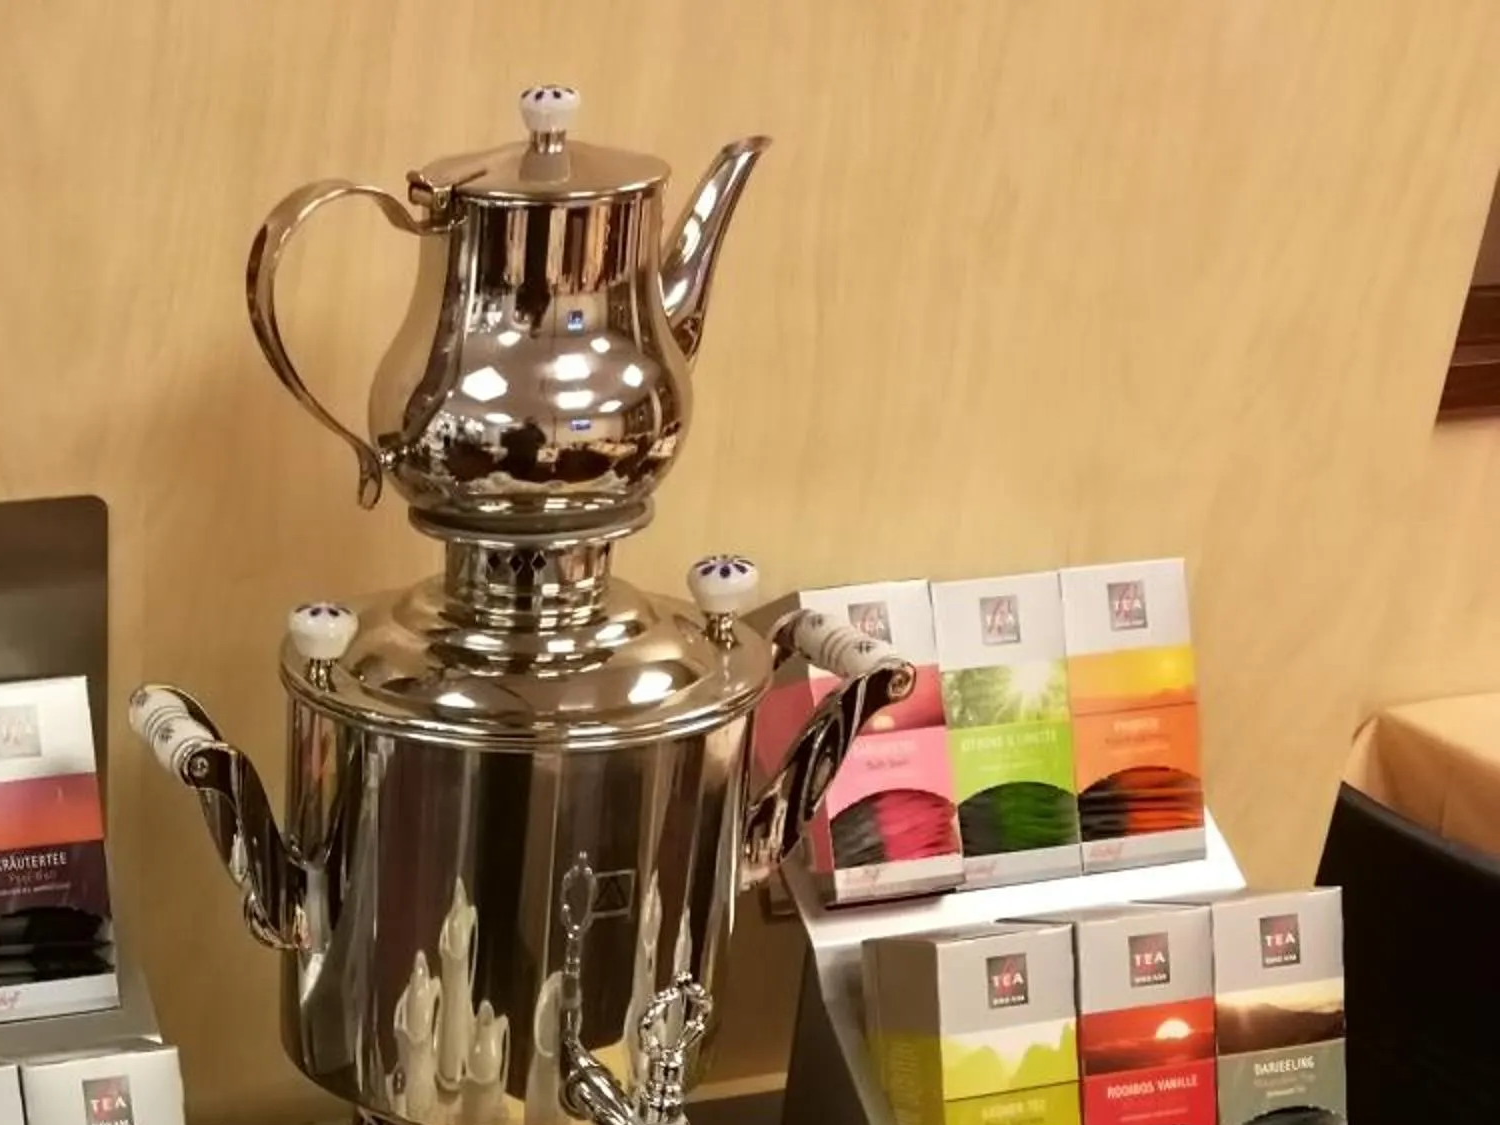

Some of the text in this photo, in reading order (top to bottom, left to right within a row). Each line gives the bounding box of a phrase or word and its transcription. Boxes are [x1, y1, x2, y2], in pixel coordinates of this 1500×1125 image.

[1265, 932, 1296, 947] TEA
[1134, 951, 1166, 967] TEA
[992, 972, 1024, 987] TEA
[90, 1096, 128, 1112] TEA
